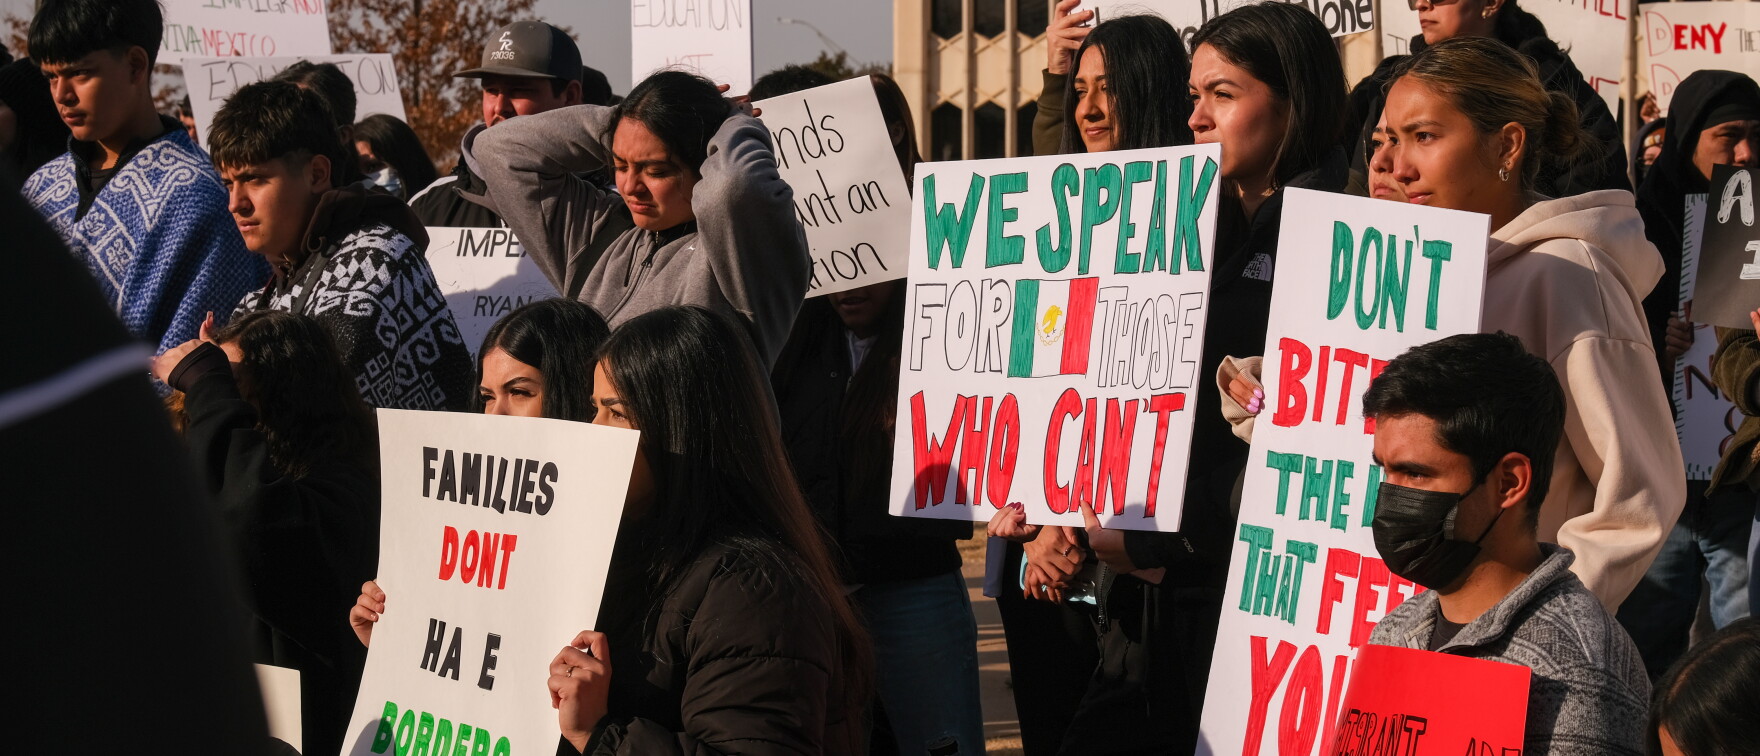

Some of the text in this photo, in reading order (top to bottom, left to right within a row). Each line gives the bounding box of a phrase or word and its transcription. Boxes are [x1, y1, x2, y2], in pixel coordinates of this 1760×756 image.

[490, 51, 515, 60] 73036
[1645, 11, 1760, 55] DENY THE
[776, 99, 844, 170] nds
[848, 180, 890, 214] an
[922, 154, 1218, 275] WE SPEAK
[456, 229, 527, 258] IMPE
[1242, 268, 1260, 280] FACE
[1326, 220, 1453, 333] DON'T
[909, 278, 1203, 390] FOR THOSE
[422, 446, 559, 516] FAMILIES
[910, 387, 1187, 519] WHO CAN'T
[1266, 449, 1355, 533] THE
[438, 525, 518, 590] DONT
[1238, 523, 1318, 626] THAT
